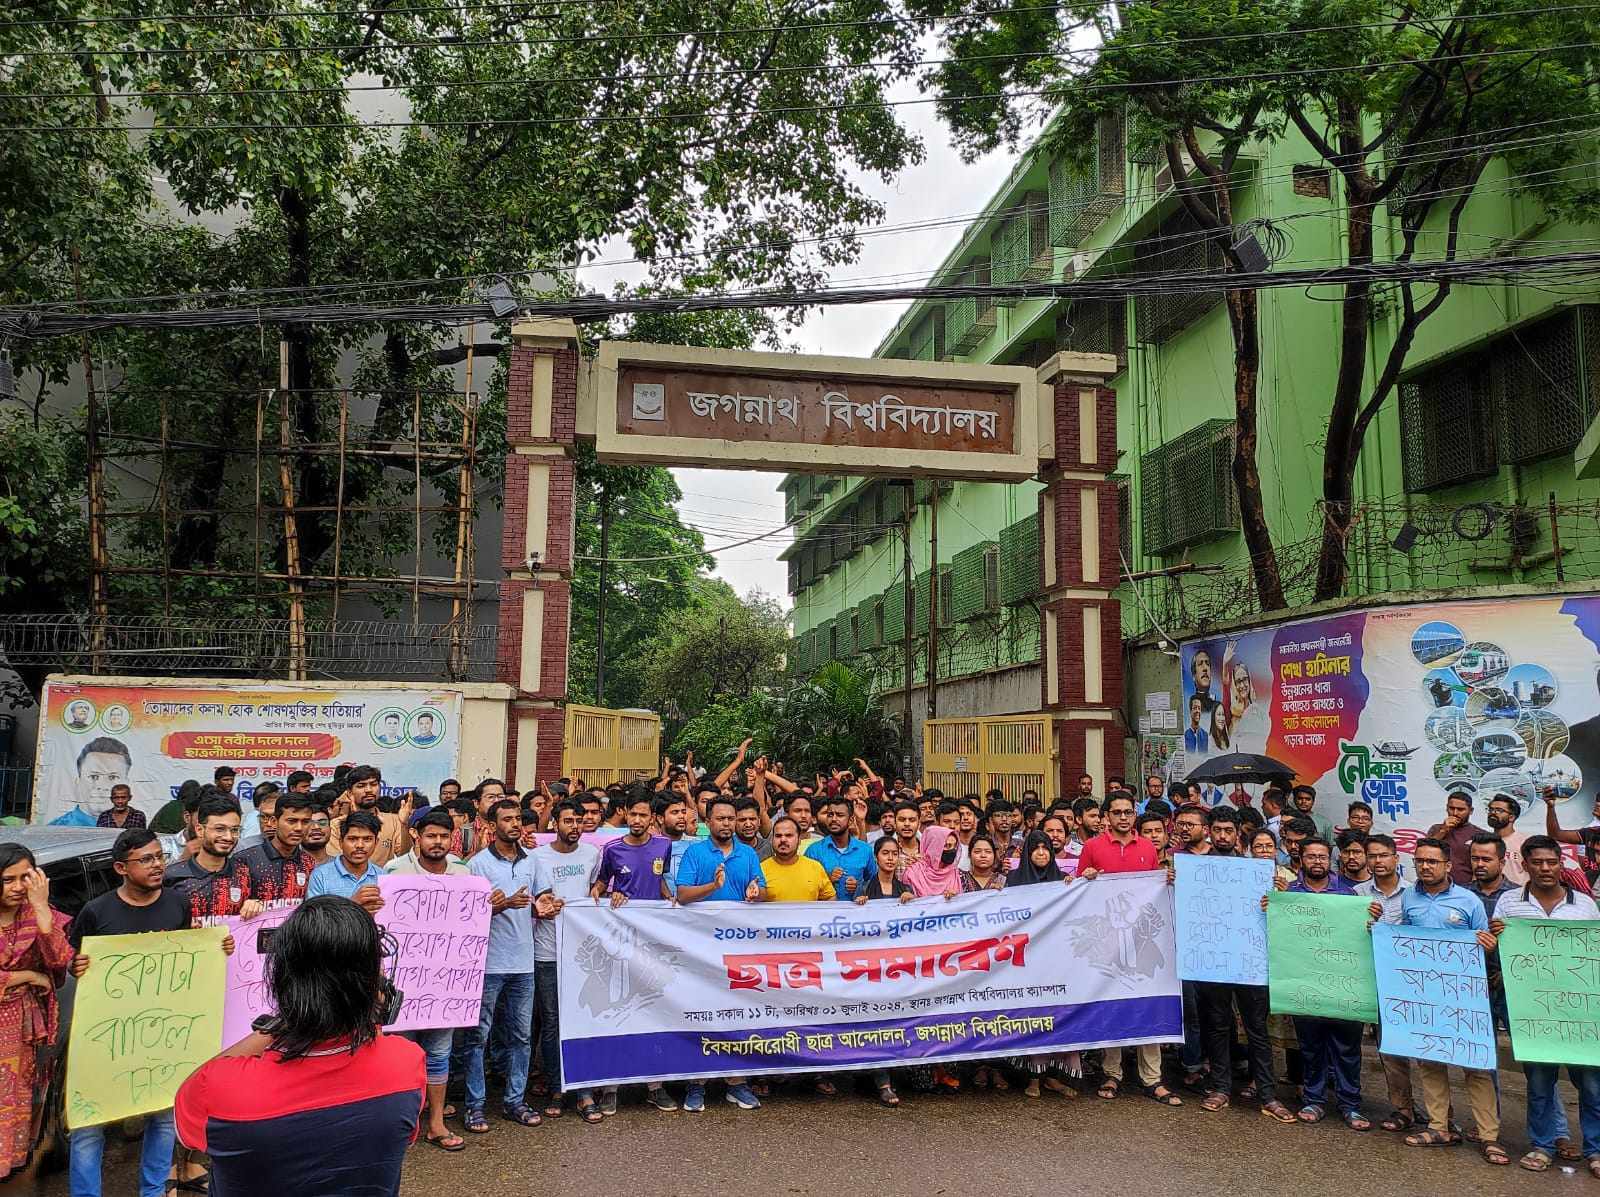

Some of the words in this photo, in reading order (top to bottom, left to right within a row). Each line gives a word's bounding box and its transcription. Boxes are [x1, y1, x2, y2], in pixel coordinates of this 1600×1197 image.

[686, 391, 800, 427] জগন্নাথ
[820, 391, 999, 440] বিশ্ববিদ্যালয়
[1281, 662, 1302, 682] শেখ
[1305, 652, 1351, 677] হাসিনার
[1281, 683, 1312, 701] উন্নয়নের
[1314, 682, 1331, 694] ধারা
[1281, 700, 1310, 712] অব্যাহত
[1312, 698, 1335, 710] রাখতে
[1337, 697, 1344, 709] ও
[198, 703, 224, 717] কলম
[227, 703, 254, 717] হোক
[258, 701, 318, 720] শোষণমুক্তির
[1301, 715, 1340, 730] বাংলাদেশ
[184, 745, 246, 758] ছাত্রলীগের
[249, 749, 288, 758] পতাকা
[290, 749, 316, 758] তলে
[194, 735, 221, 745] এসো
[223, 733, 255, 746] নবীন
[257, 736, 281, 746] দলে
[284, 736, 309, 746] দলে
[1284, 734, 1304, 748] গড়ার
[1305, 734, 1326, 746] লক্ষ্যে
[1339, 741, 1406, 794] নৌকায়
[1361, 774, 1408, 804] ভোট
[1378, 795, 1410, 822] দিন
[392, 876, 454, 922] কোটা
[714, 926, 759, 940] ২০১৮
[766, 926, 812, 940] সালের
[819, 917, 881, 939] পরিপত্র
[886, 911, 979, 939] পুনর্বহালের
[985, 907, 1032, 926] দাবিতে
[99, 936, 206, 999] কোটা
[722, 951, 824, 992] ছাত্র
[834, 933, 1031, 986] সমাবেশ
[1510, 952, 1562, 982] শেখ
[716, 1008, 744, 1020] সকাল
[748, 1008, 761, 1019] ১১
[765, 1005, 780, 1019] টা,
[783, 1003, 819, 1016] তারিখঃ
[822, 1005, 837, 1015] ০১
[841, 1001, 870, 1017] জুলাই
[872, 1002, 905, 1013] ২০২৪,
[909, 998, 932, 1012] স্থানঃ
[934, 991, 966, 1007] জগন্নাথ
[968, 986, 1024, 1003] বিশ্ববিদ্যালয়
[1027, 984, 1067, 998] ক্যাম্পাস
[1384, 991, 1440, 1026] কোটা
[85, 1008, 206, 1062] বাতিল
[702, 1031, 801, 1056] বৈষম্যবিরোধী
[805, 1033, 833, 1052] ছাত্র
[837, 1027, 912, 1050] আন্দোলন,
[914, 1022, 966, 1043] জগন্নাথ
[970, 1014, 1055, 1038] বিশ্ববিদ্যালয়
